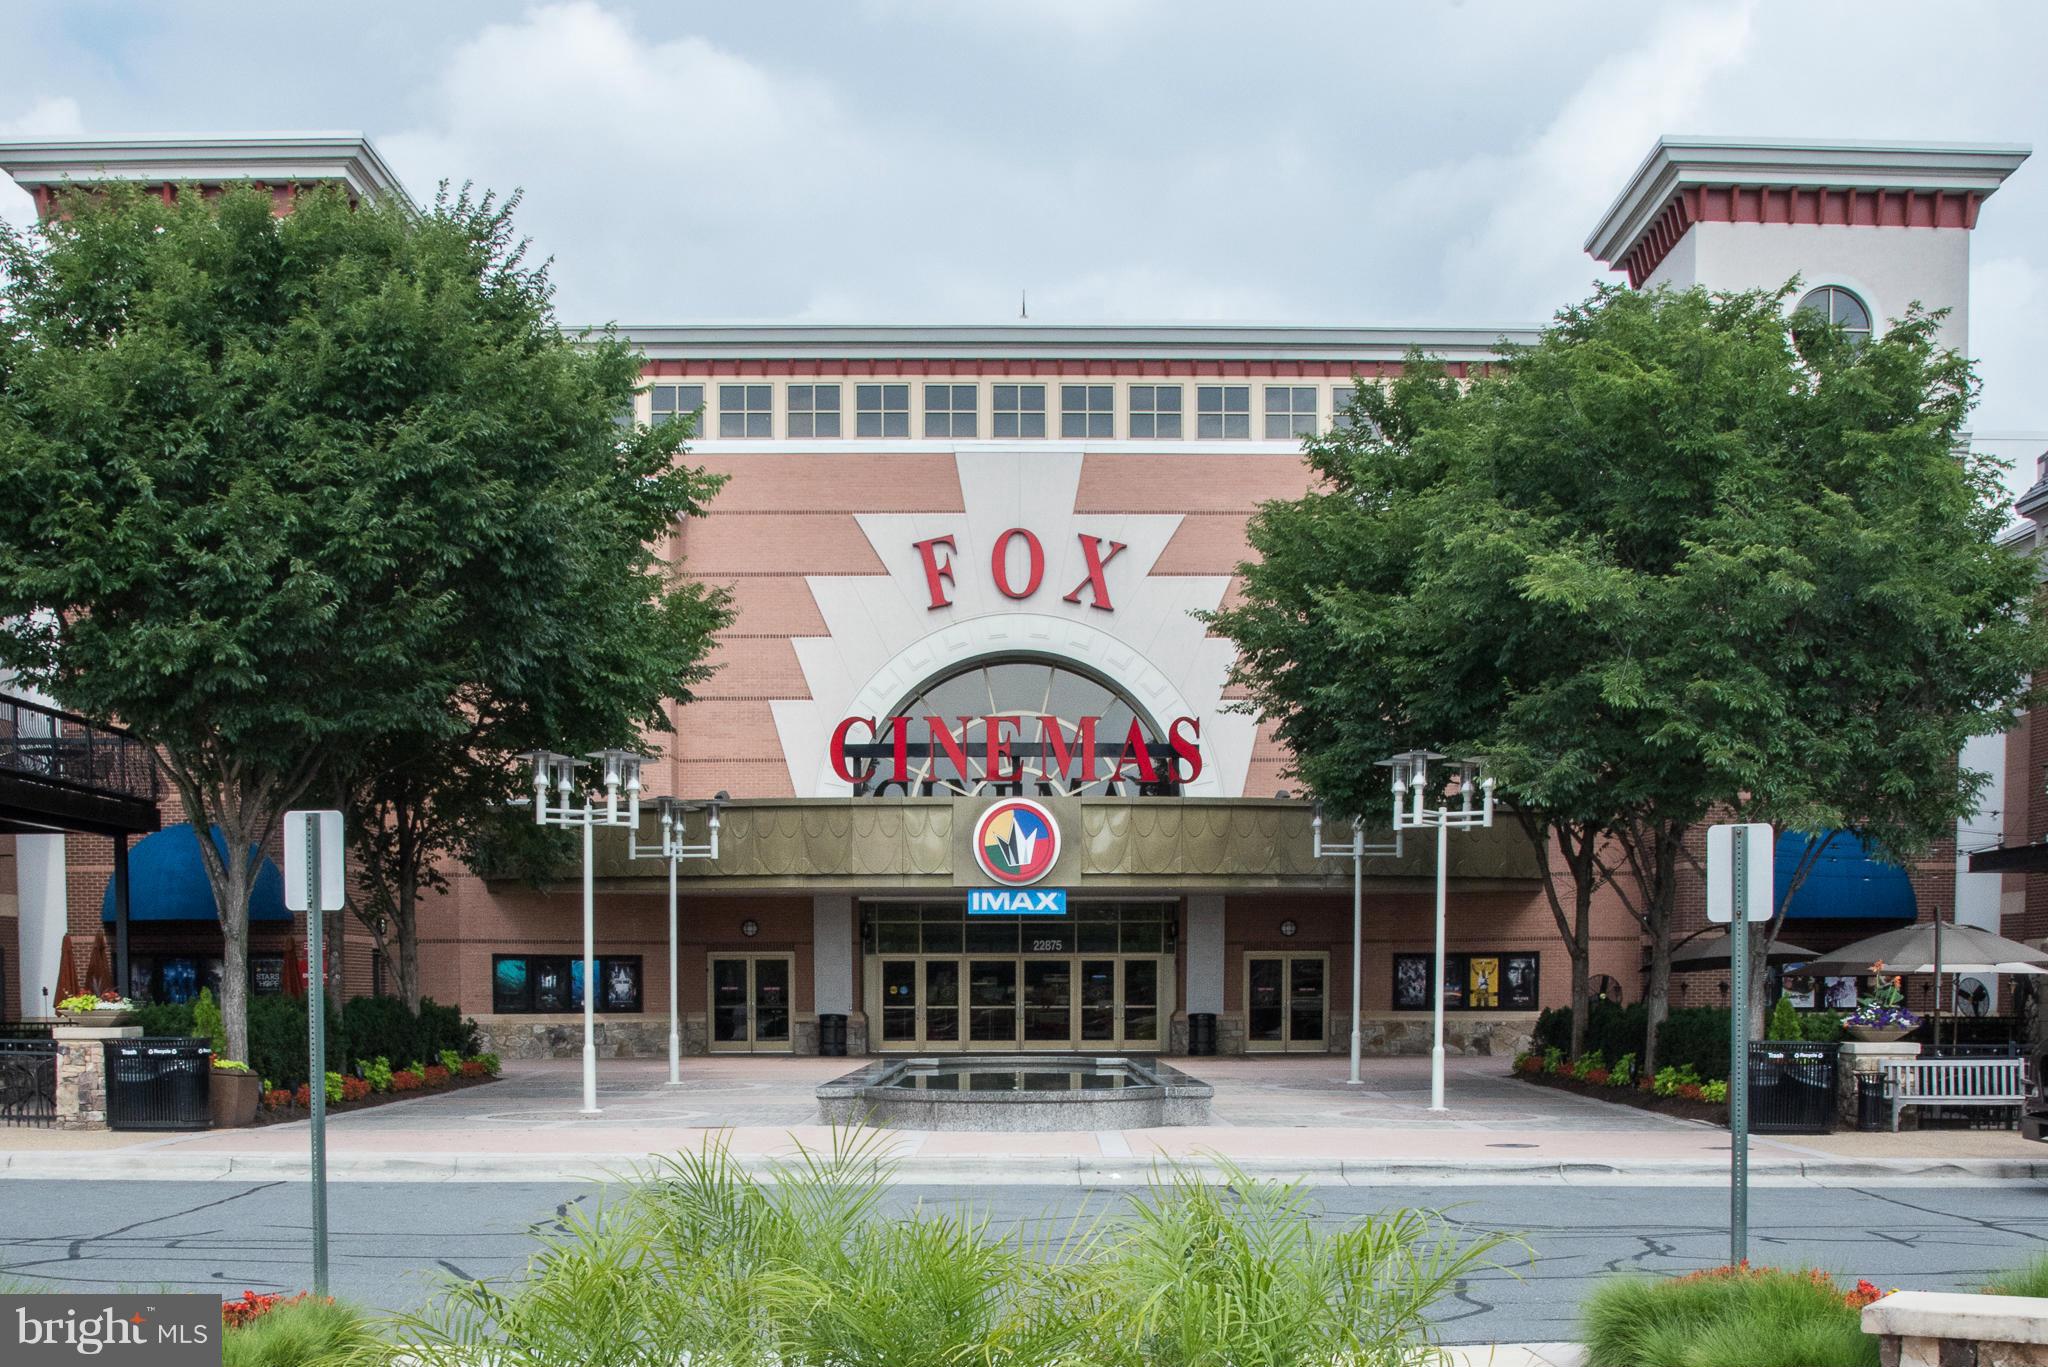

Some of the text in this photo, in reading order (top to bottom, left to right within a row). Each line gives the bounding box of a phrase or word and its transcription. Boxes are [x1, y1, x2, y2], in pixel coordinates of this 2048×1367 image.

[912, 527, 1128, 612] FOX
[829, 716, 1204, 784] CINEMAS
[972, 892, 1059, 911] IMAX
[1033, 940, 1063, 951] 22875
